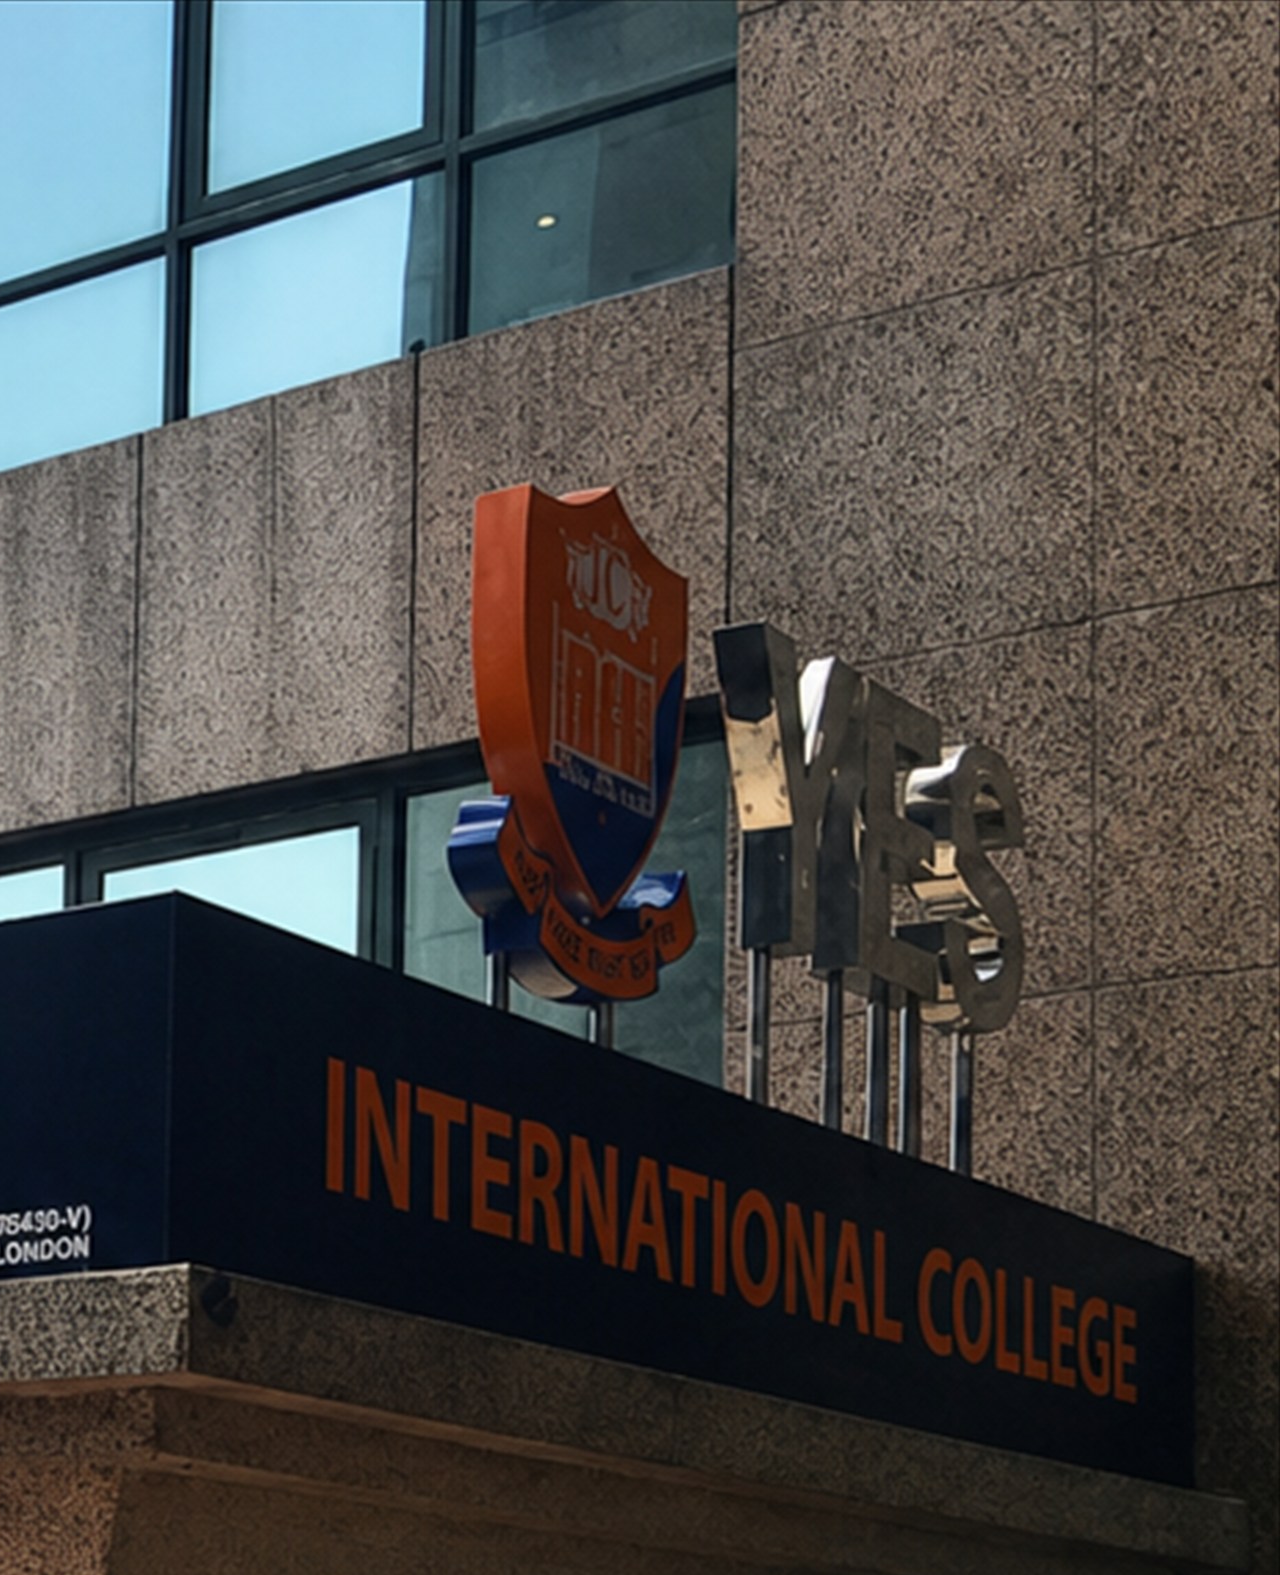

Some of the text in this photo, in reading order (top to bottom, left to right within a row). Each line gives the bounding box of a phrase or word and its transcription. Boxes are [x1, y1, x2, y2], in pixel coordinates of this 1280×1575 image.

[714, 622, 1025, 1035] YES
[325, 1057, 1137, 1402] INTERNATIONAL COLLEGE
